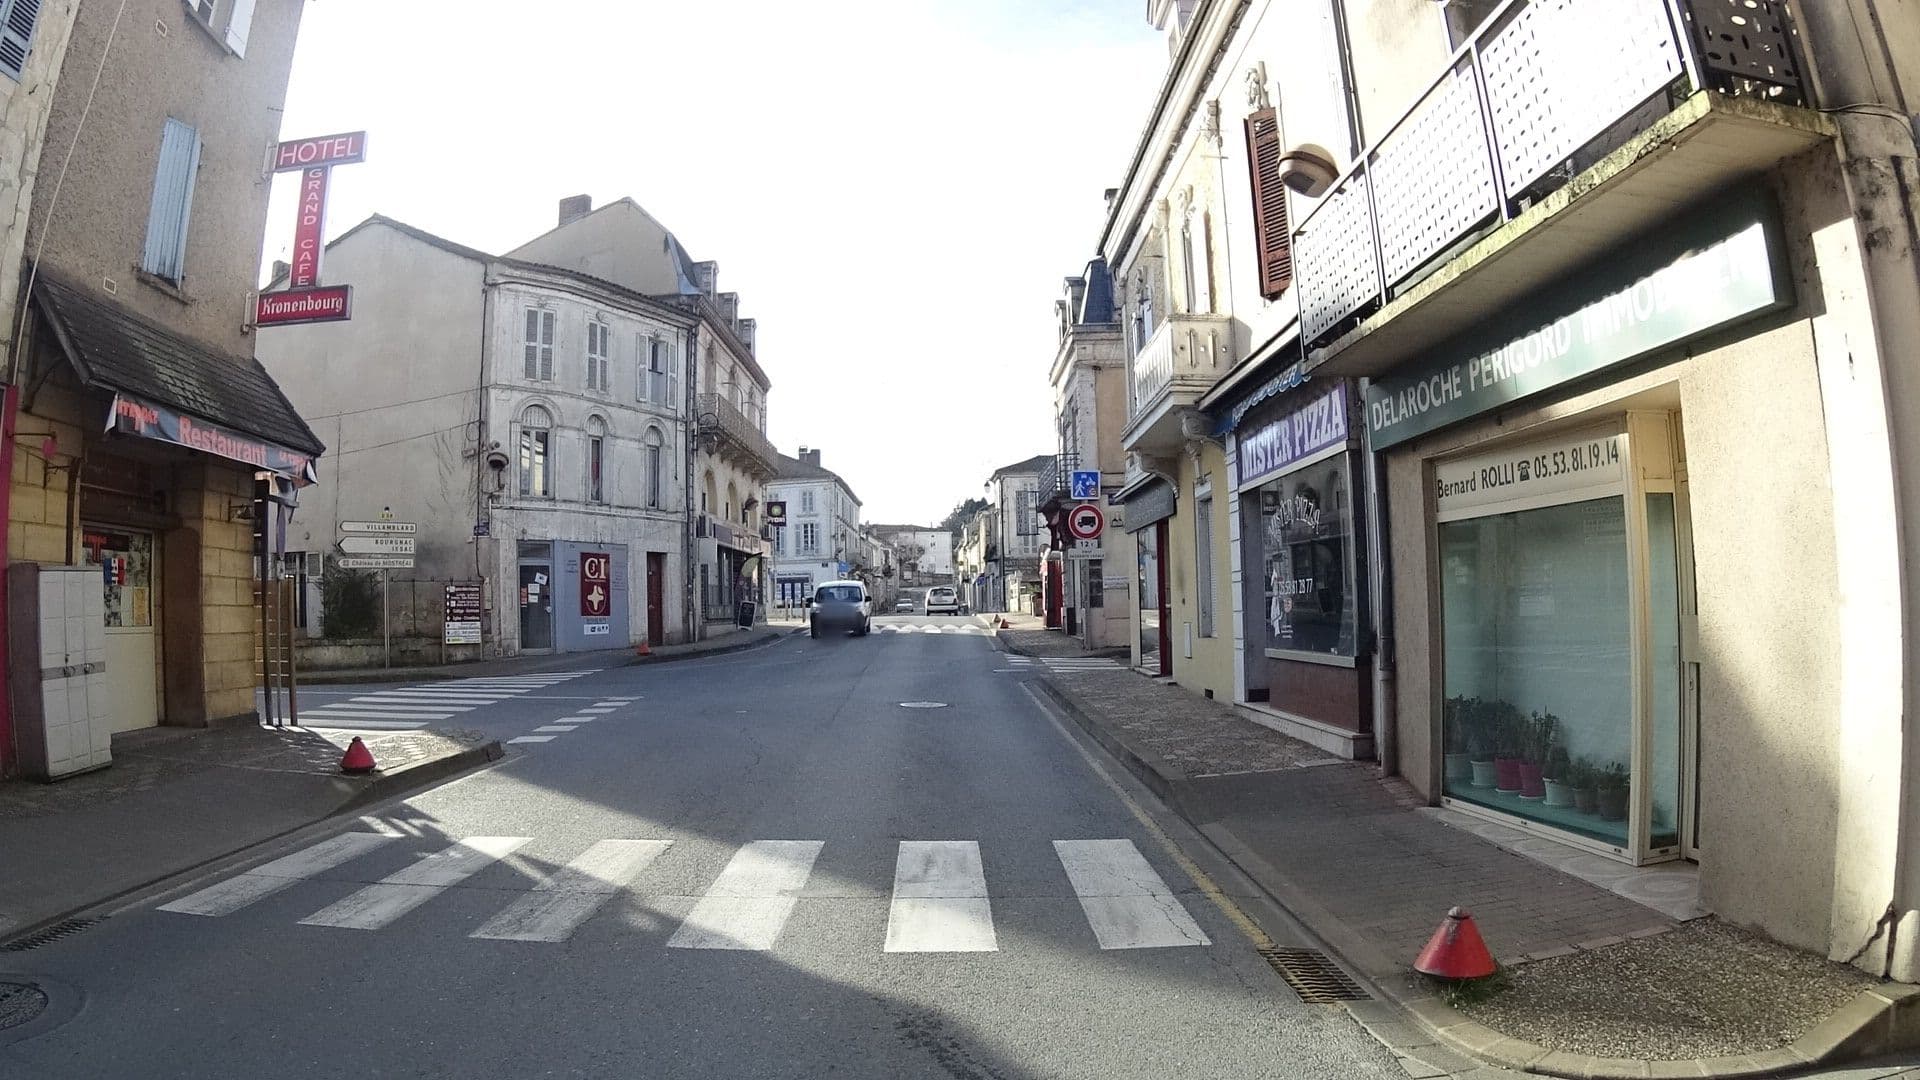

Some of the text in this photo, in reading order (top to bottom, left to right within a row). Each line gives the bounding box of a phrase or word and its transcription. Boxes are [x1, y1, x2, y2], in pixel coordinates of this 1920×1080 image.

[280, 136, 359, 165] HOTEL
[297, 168, 323, 286] GRAND CAFE
[262, 296, 344, 316] Kronenbourg
[1372, 365, 1462, 432] DELAROCHE
[1468, 316, 1572, 392] PERIGORD
[179, 415, 267, 466] Restaurant
[1241, 419, 1293, 480] MISTER
[1293, 388, 1346, 457] PIZZA
[1437, 471, 1477, 498] Bernard
[1481, 462, 1515, 489] ROLLI
[366, 524, 415, 532] VILLAMBLARD
[1305, 577, 1313, 593] 77
